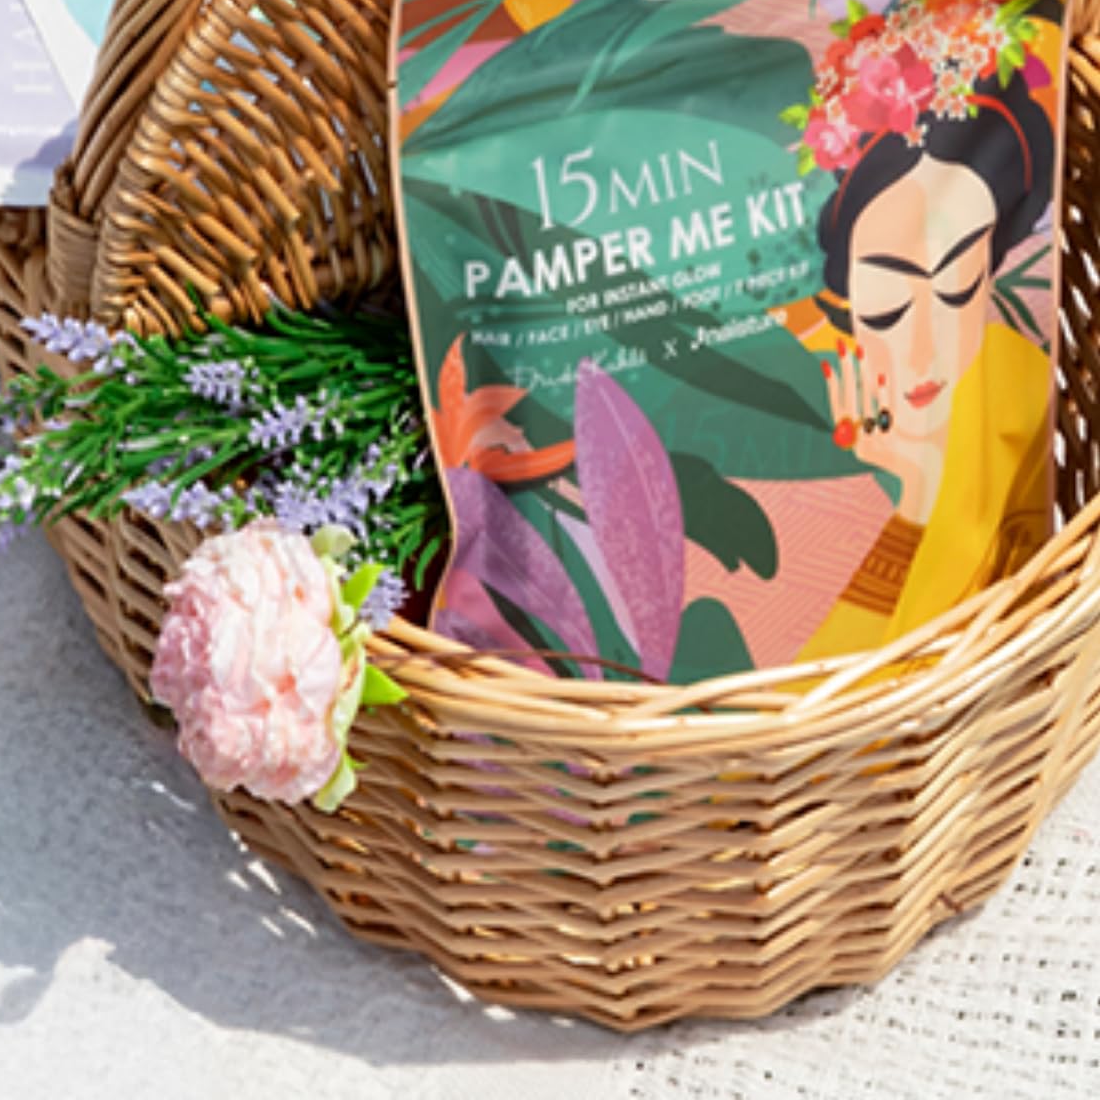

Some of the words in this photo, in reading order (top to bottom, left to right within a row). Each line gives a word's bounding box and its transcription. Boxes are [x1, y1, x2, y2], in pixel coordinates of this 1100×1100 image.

[464, 226, 656, 298] PAMPER
[669, 201, 736, 261] ME
[745, 181, 805, 239] KIT
[566, 291, 599, 314] FOR
[671, 262, 721, 290] GLOW
[527, 324, 569, 346] FACE
